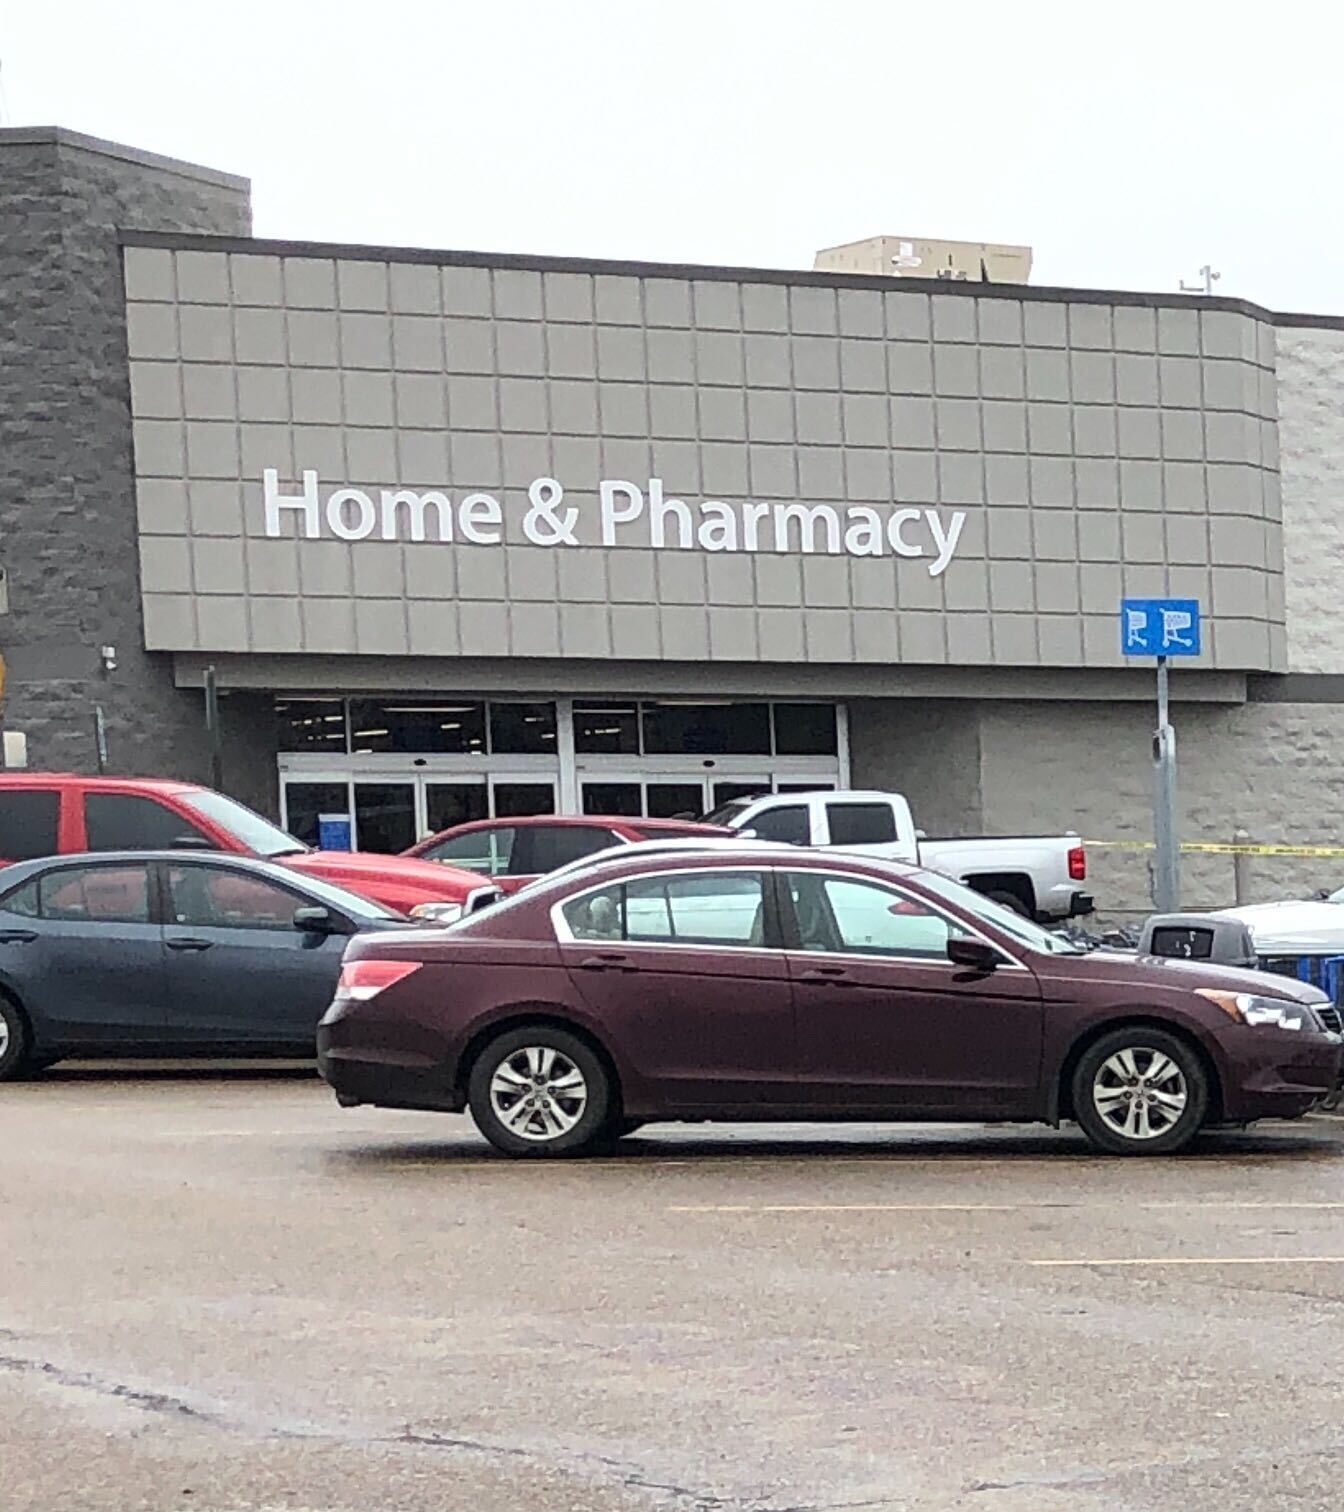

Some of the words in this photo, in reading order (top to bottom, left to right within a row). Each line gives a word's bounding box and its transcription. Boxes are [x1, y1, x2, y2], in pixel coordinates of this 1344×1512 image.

[263, 468, 502, 543] Home
[522, 477, 581, 547] &
[599, 478, 967, 576] Pharmacy
